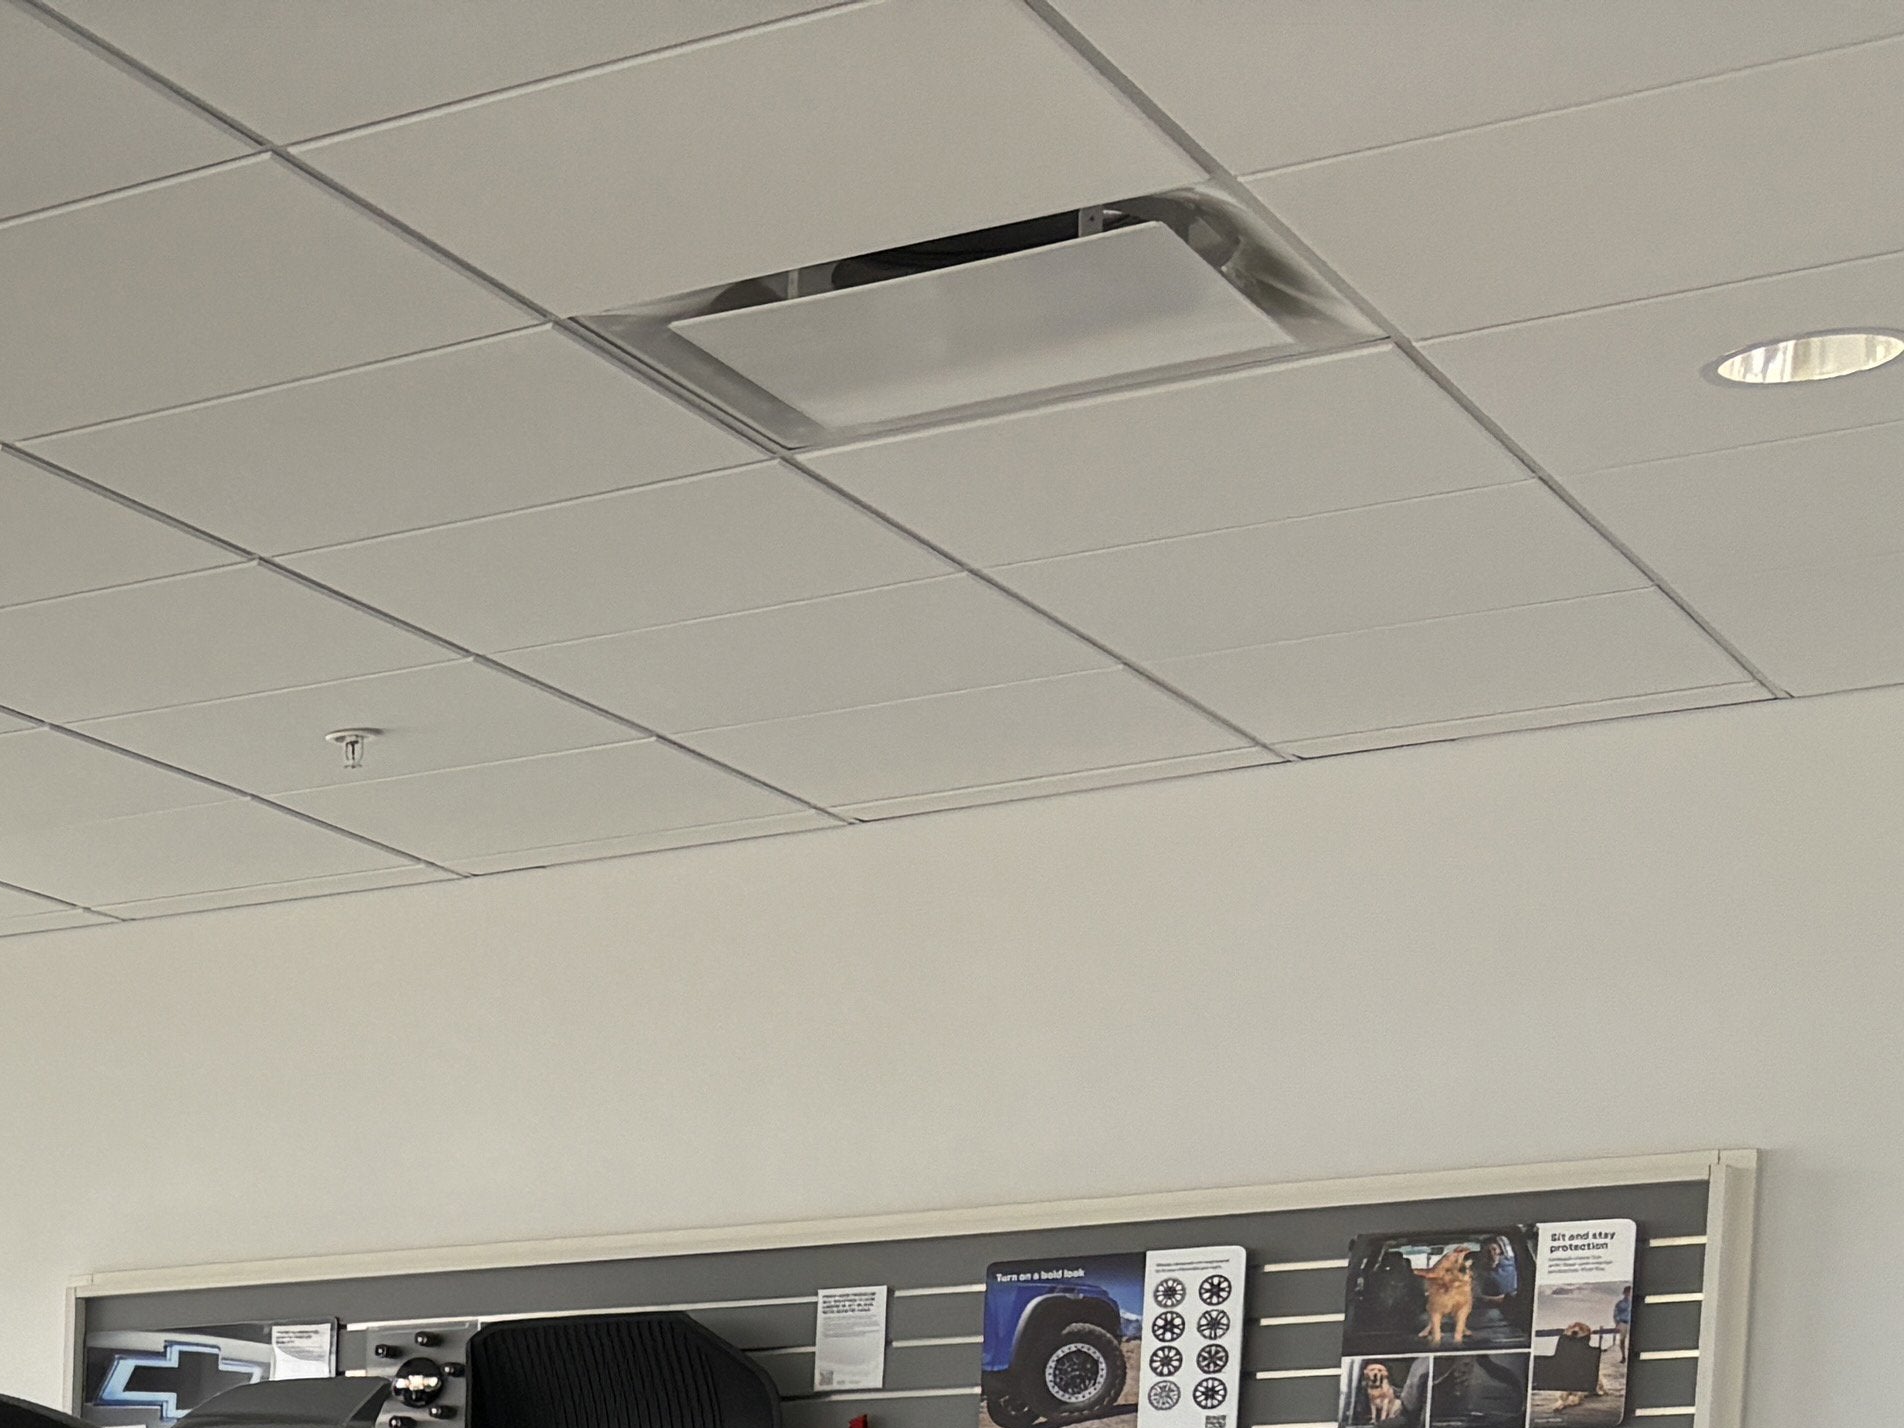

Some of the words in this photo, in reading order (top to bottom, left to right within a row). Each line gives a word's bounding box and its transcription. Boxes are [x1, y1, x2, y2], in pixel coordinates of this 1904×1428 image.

[1551, 1232, 1566, 1242] Sit
[1568, 1231, 1590, 1242] and
[1592, 1231, 1617, 1241] stay
[1549, 1242, 1609, 1254] protection
[996, 1273, 1018, 1283] Turn
[1019, 1273, 1032, 1281] on
[1040, 1269, 1063, 1280] bold
[1063, 1268, 1086, 1278] look
